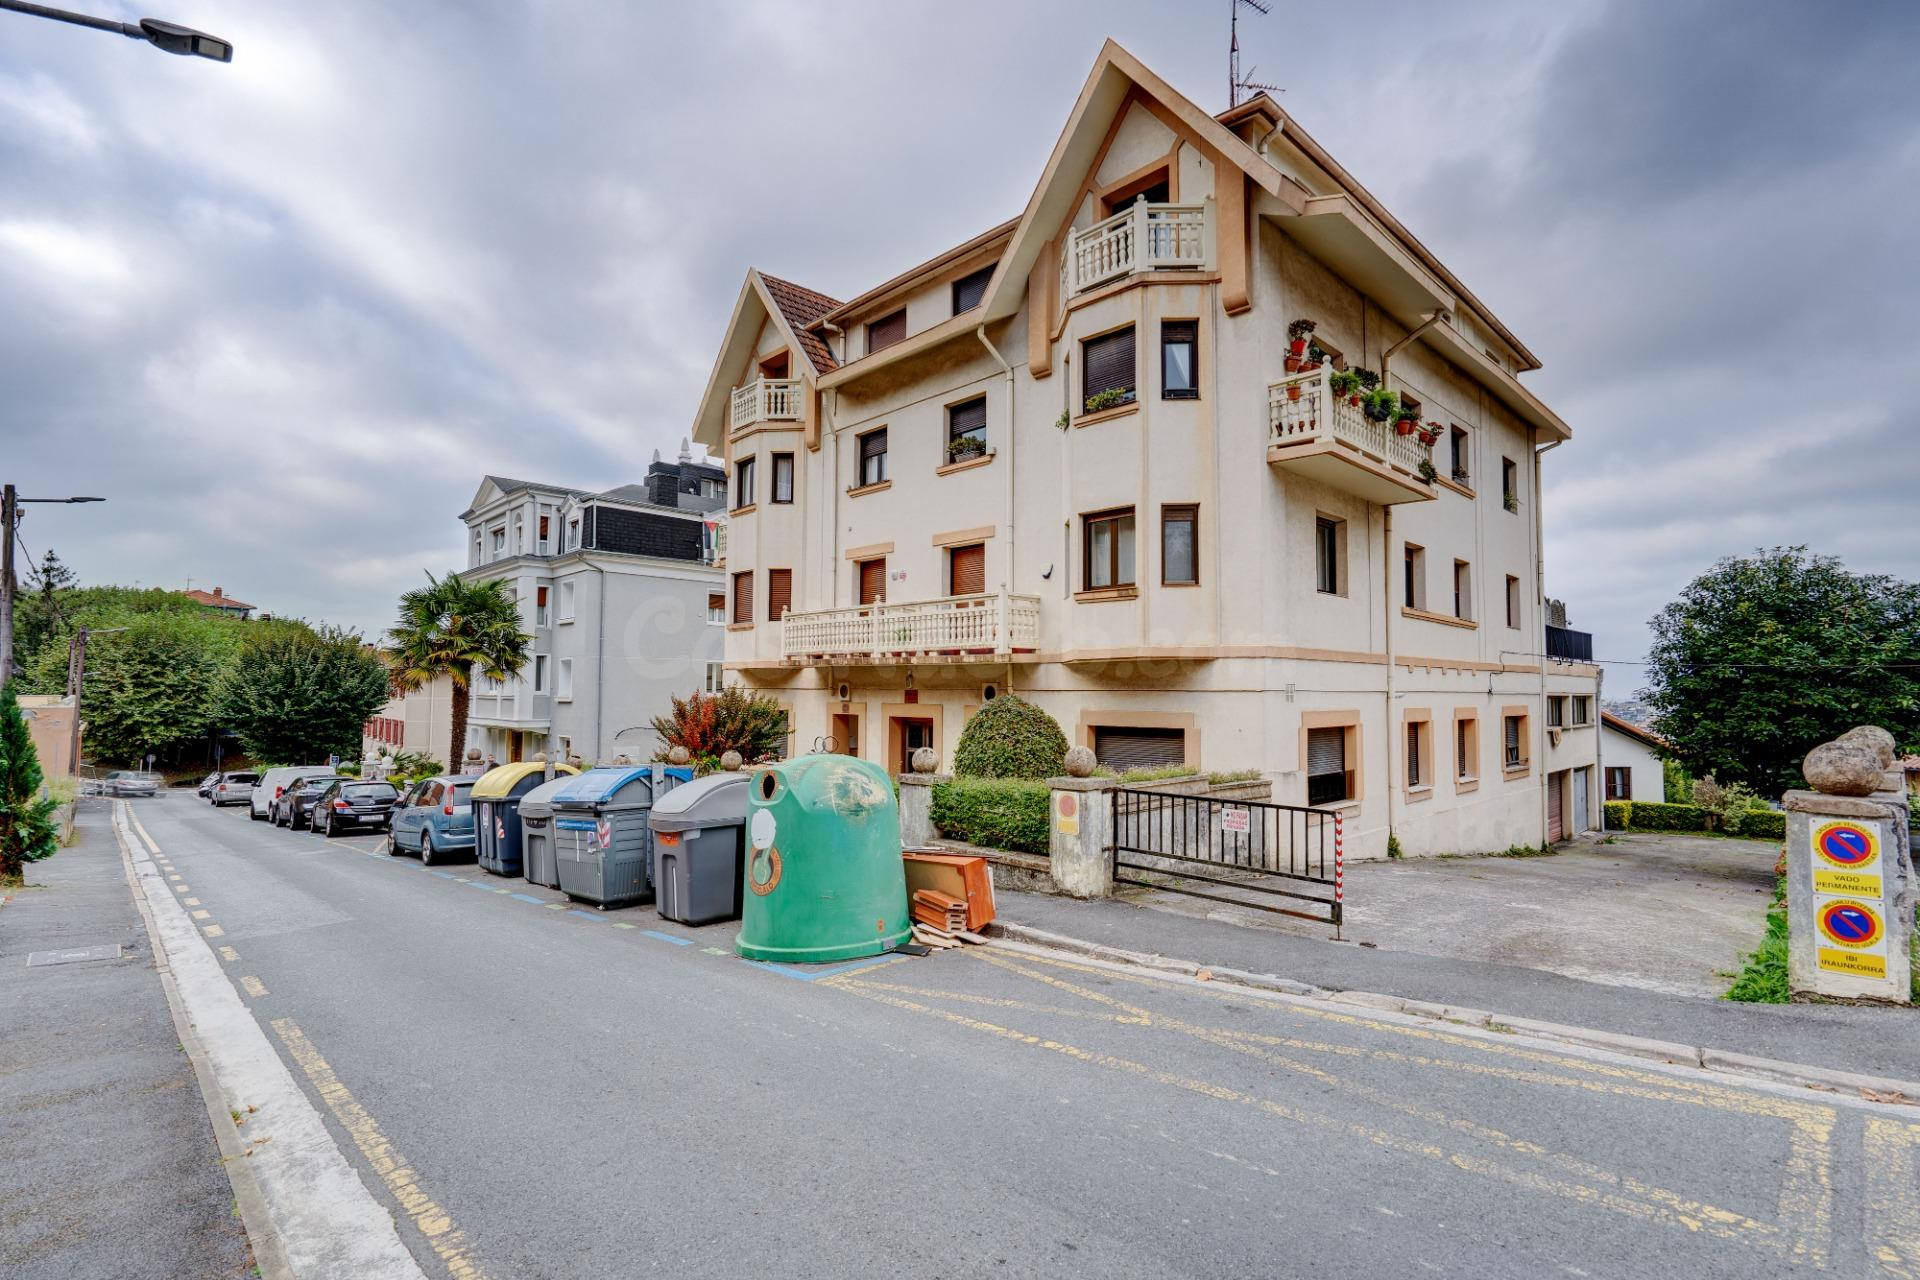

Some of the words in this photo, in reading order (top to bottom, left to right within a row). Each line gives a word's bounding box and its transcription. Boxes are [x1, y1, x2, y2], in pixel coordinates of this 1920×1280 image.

[1834, 874, 1861, 884] VADO
[1815, 881, 1880, 894] PERMANENTE
[1845, 954, 1858, 963] IBI
[1820, 959, 1885, 974] IRAUNKORRA
